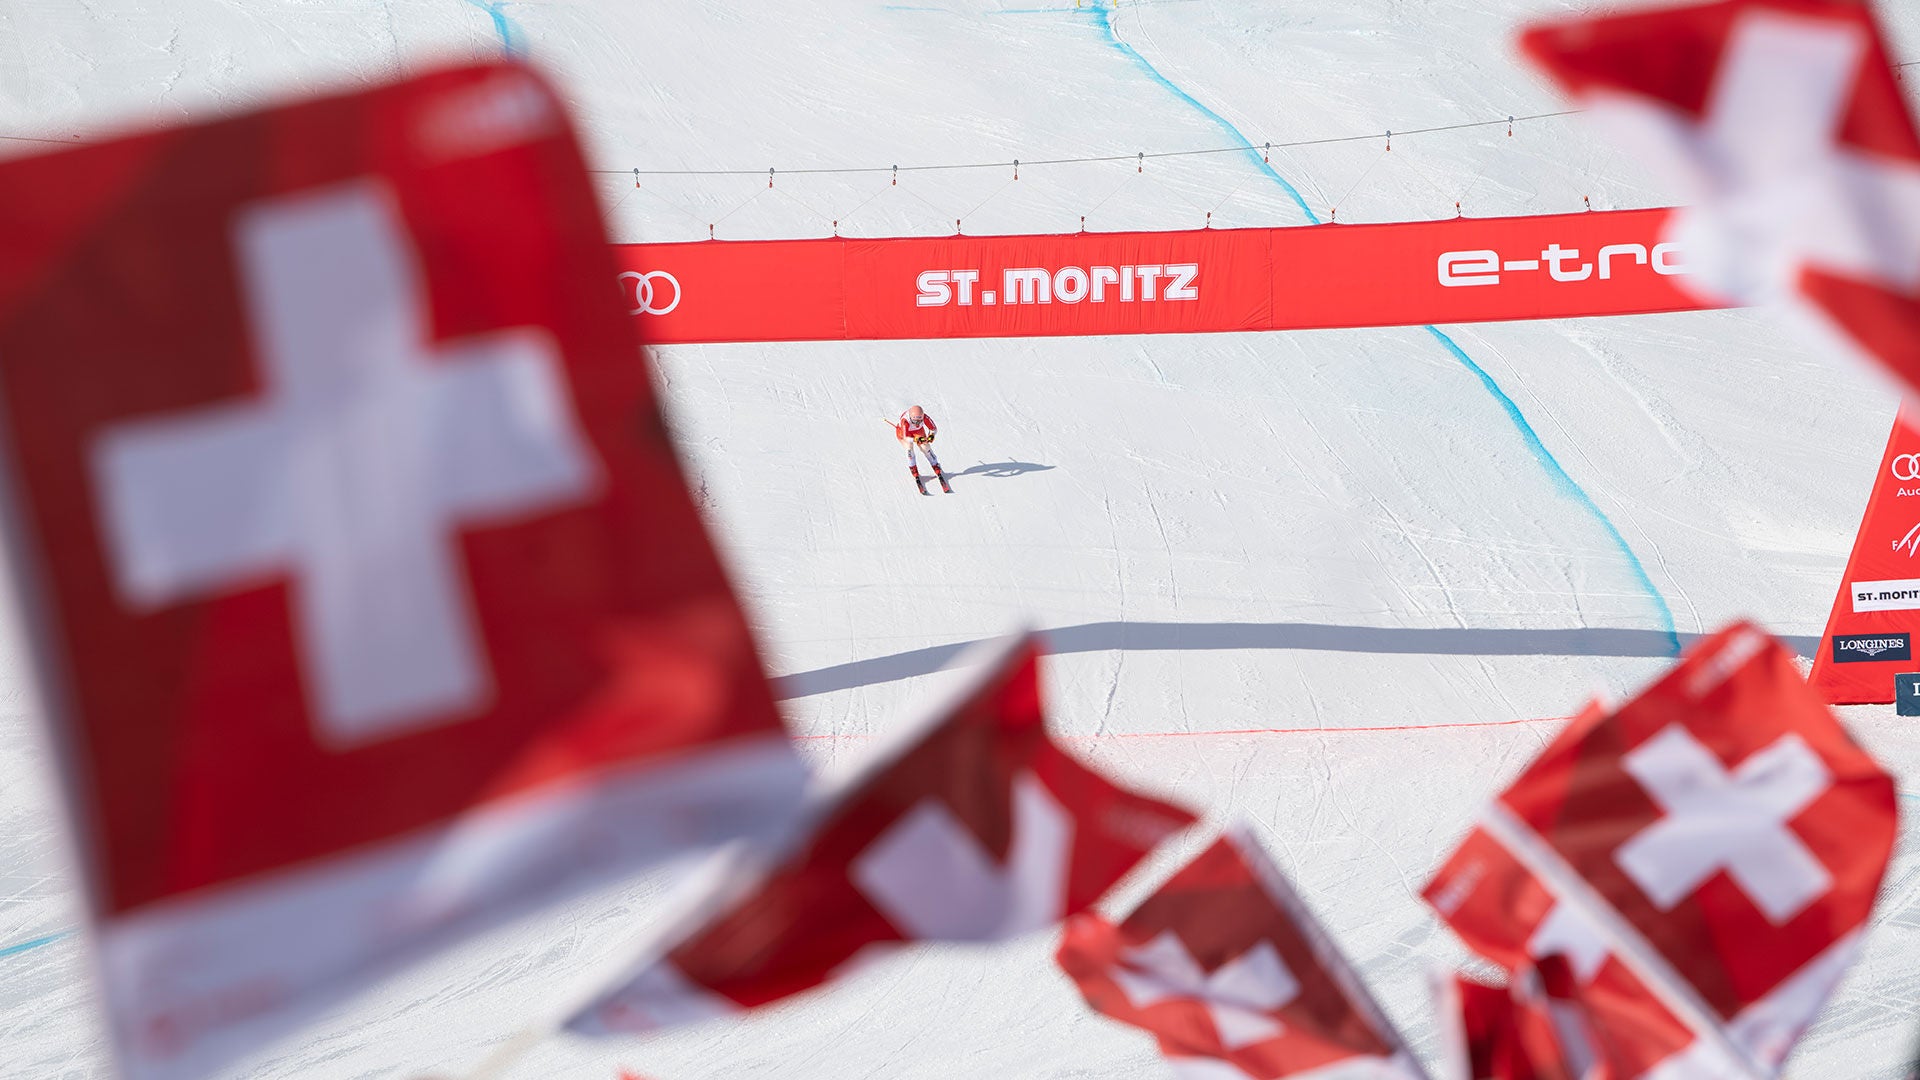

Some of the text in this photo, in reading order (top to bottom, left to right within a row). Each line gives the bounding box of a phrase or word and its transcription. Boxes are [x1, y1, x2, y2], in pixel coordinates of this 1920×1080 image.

[1437, 242, 1692, 287] e-tro
[916, 263, 1199, 307] ST.MORITZ
[1857, 590, 1920, 601] ST.MORIT
[1840, 639, 1904, 650] LONGINES
